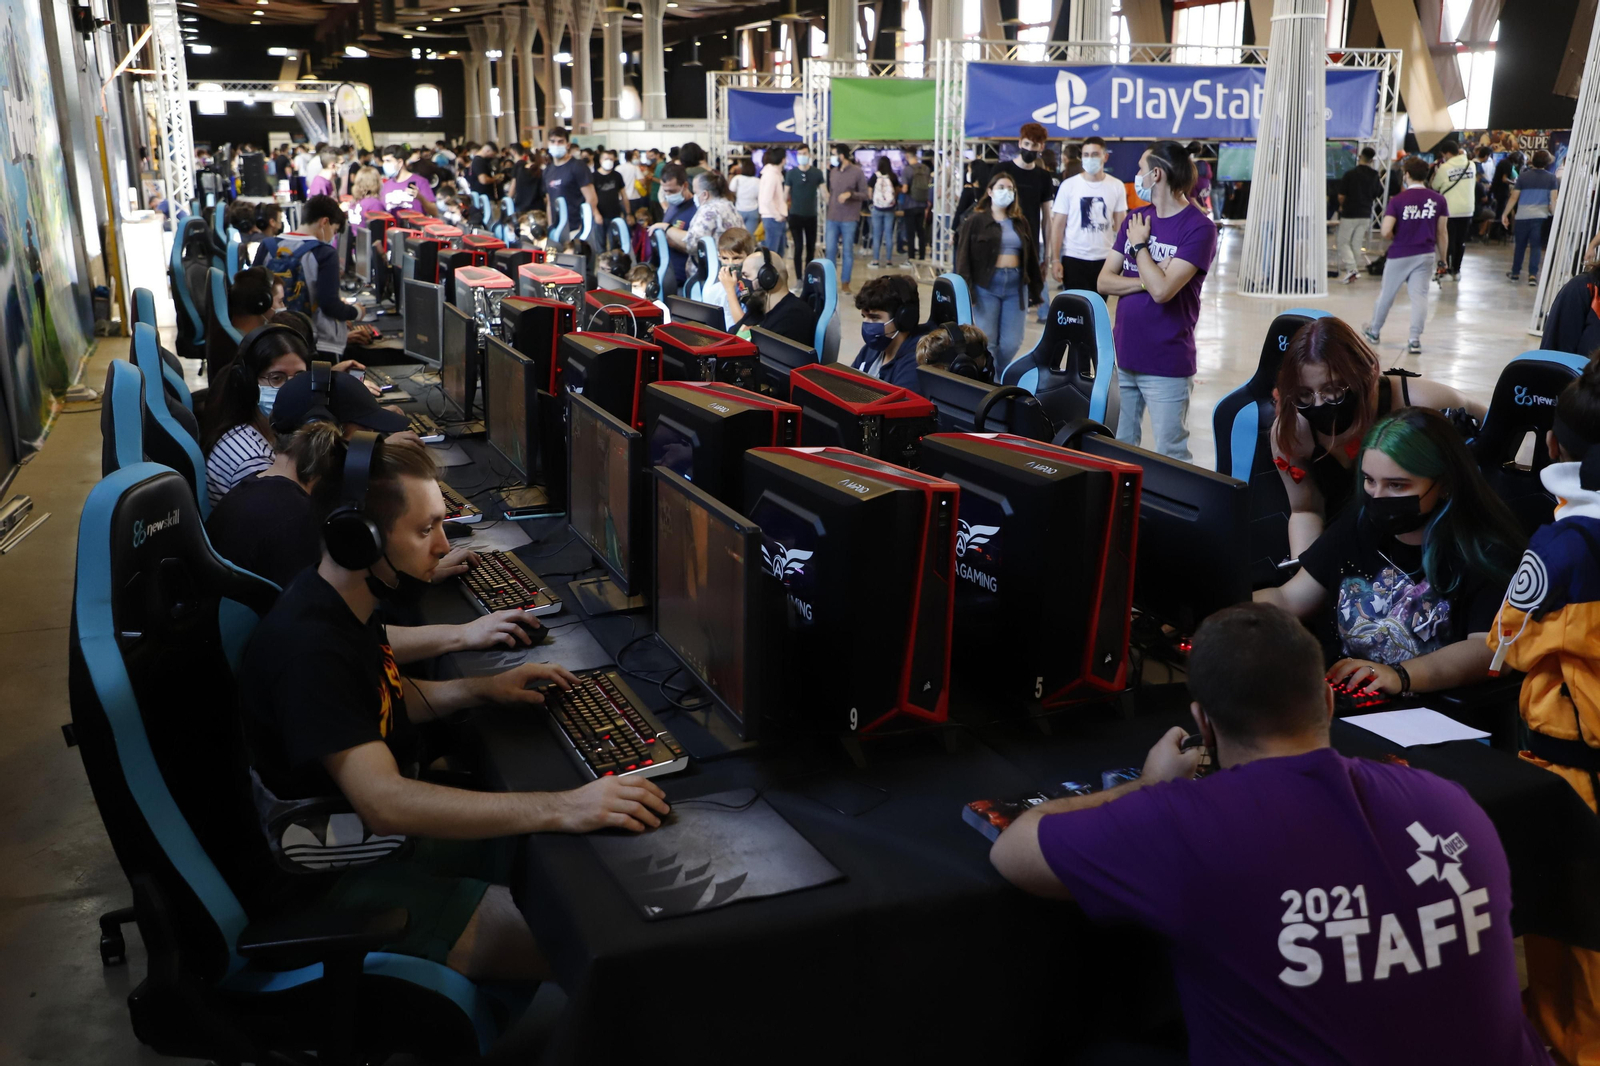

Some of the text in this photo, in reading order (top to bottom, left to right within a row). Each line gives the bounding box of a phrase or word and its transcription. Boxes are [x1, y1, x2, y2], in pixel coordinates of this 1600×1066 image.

[1111, 77, 1265, 134] PlayStat
[1402, 209, 1437, 220] STAFF
[146, 508, 180, 537] newskill
[1034, 676, 1044, 699] 5
[849, 707, 858, 730] 9
[1444, 835, 1466, 856] OVER
[1280, 884, 1369, 924] 2021
[1277, 887, 1492, 987] STAFF
